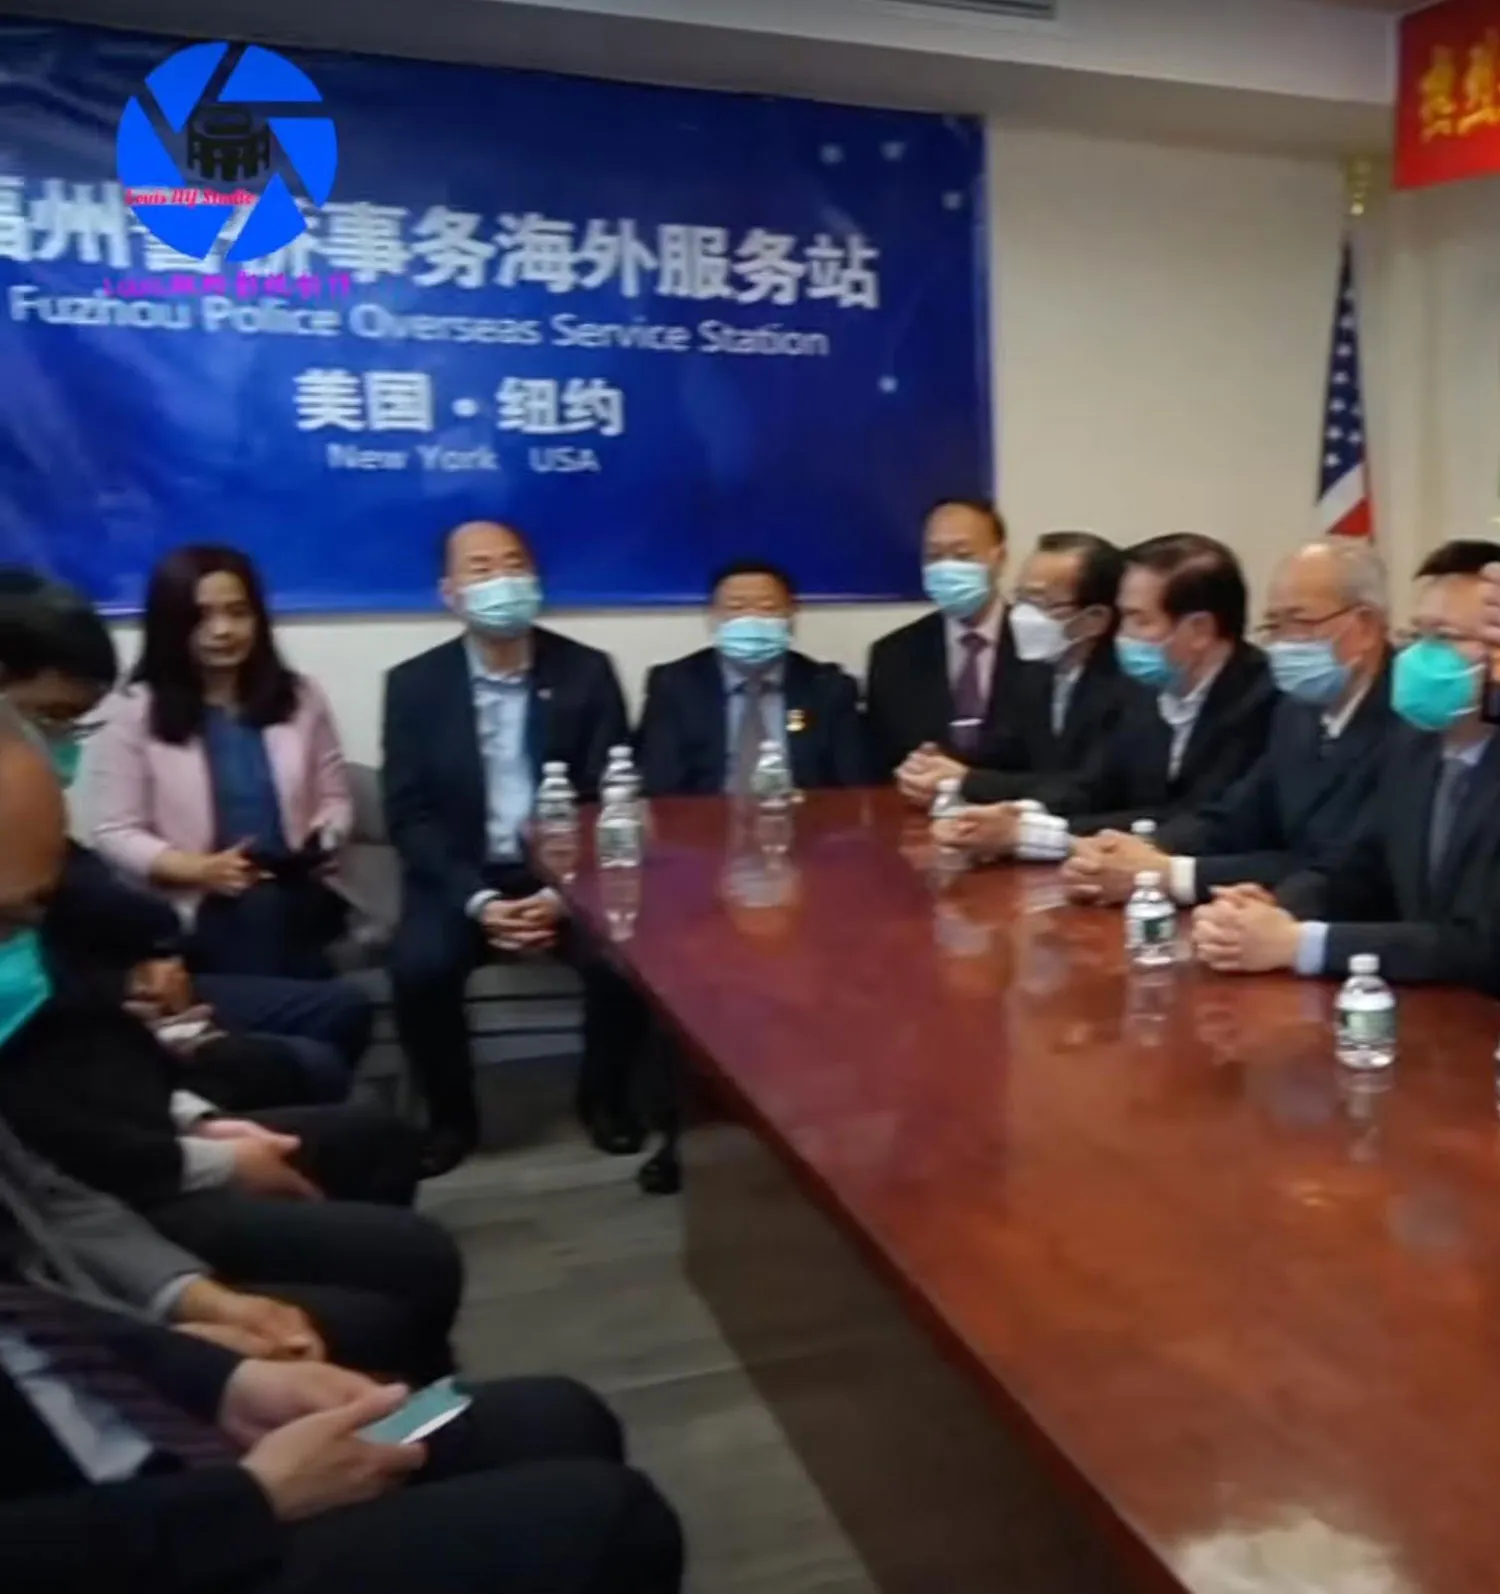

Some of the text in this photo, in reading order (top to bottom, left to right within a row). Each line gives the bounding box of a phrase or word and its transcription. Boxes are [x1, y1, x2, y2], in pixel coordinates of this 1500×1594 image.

[0, 175, 881, 309] 州事务海外服务站
[9, 285, 830, 357] Fuzhou Police Overseas Service Station
[326, 442, 601, 473] New York USA
